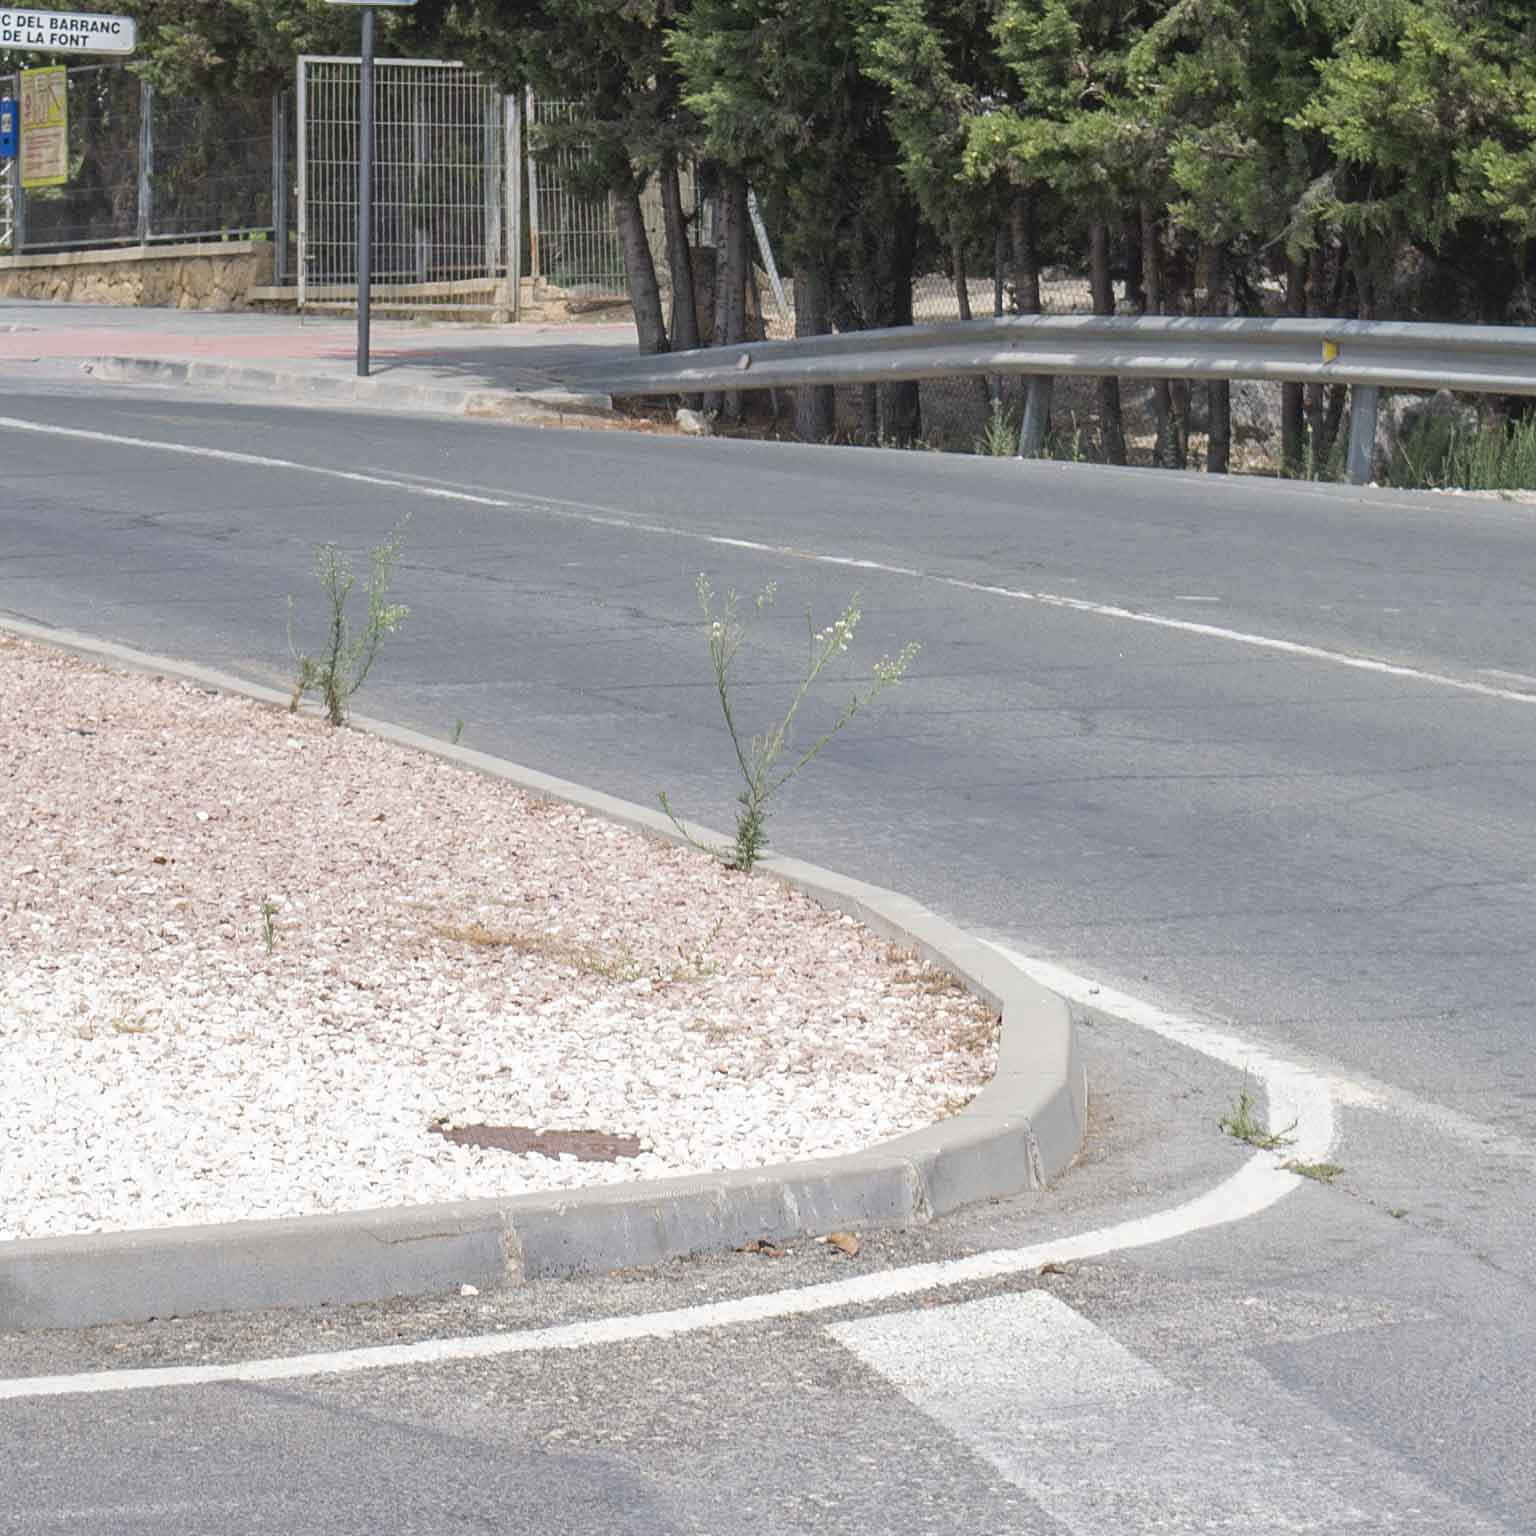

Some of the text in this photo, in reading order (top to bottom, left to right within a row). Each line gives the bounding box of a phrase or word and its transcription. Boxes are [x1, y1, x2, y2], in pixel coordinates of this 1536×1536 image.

[16, 15, 45, 29] DEL
[49, 18, 121, 35] BARRANC
[2, 29, 90, 48] DE LA FONT
